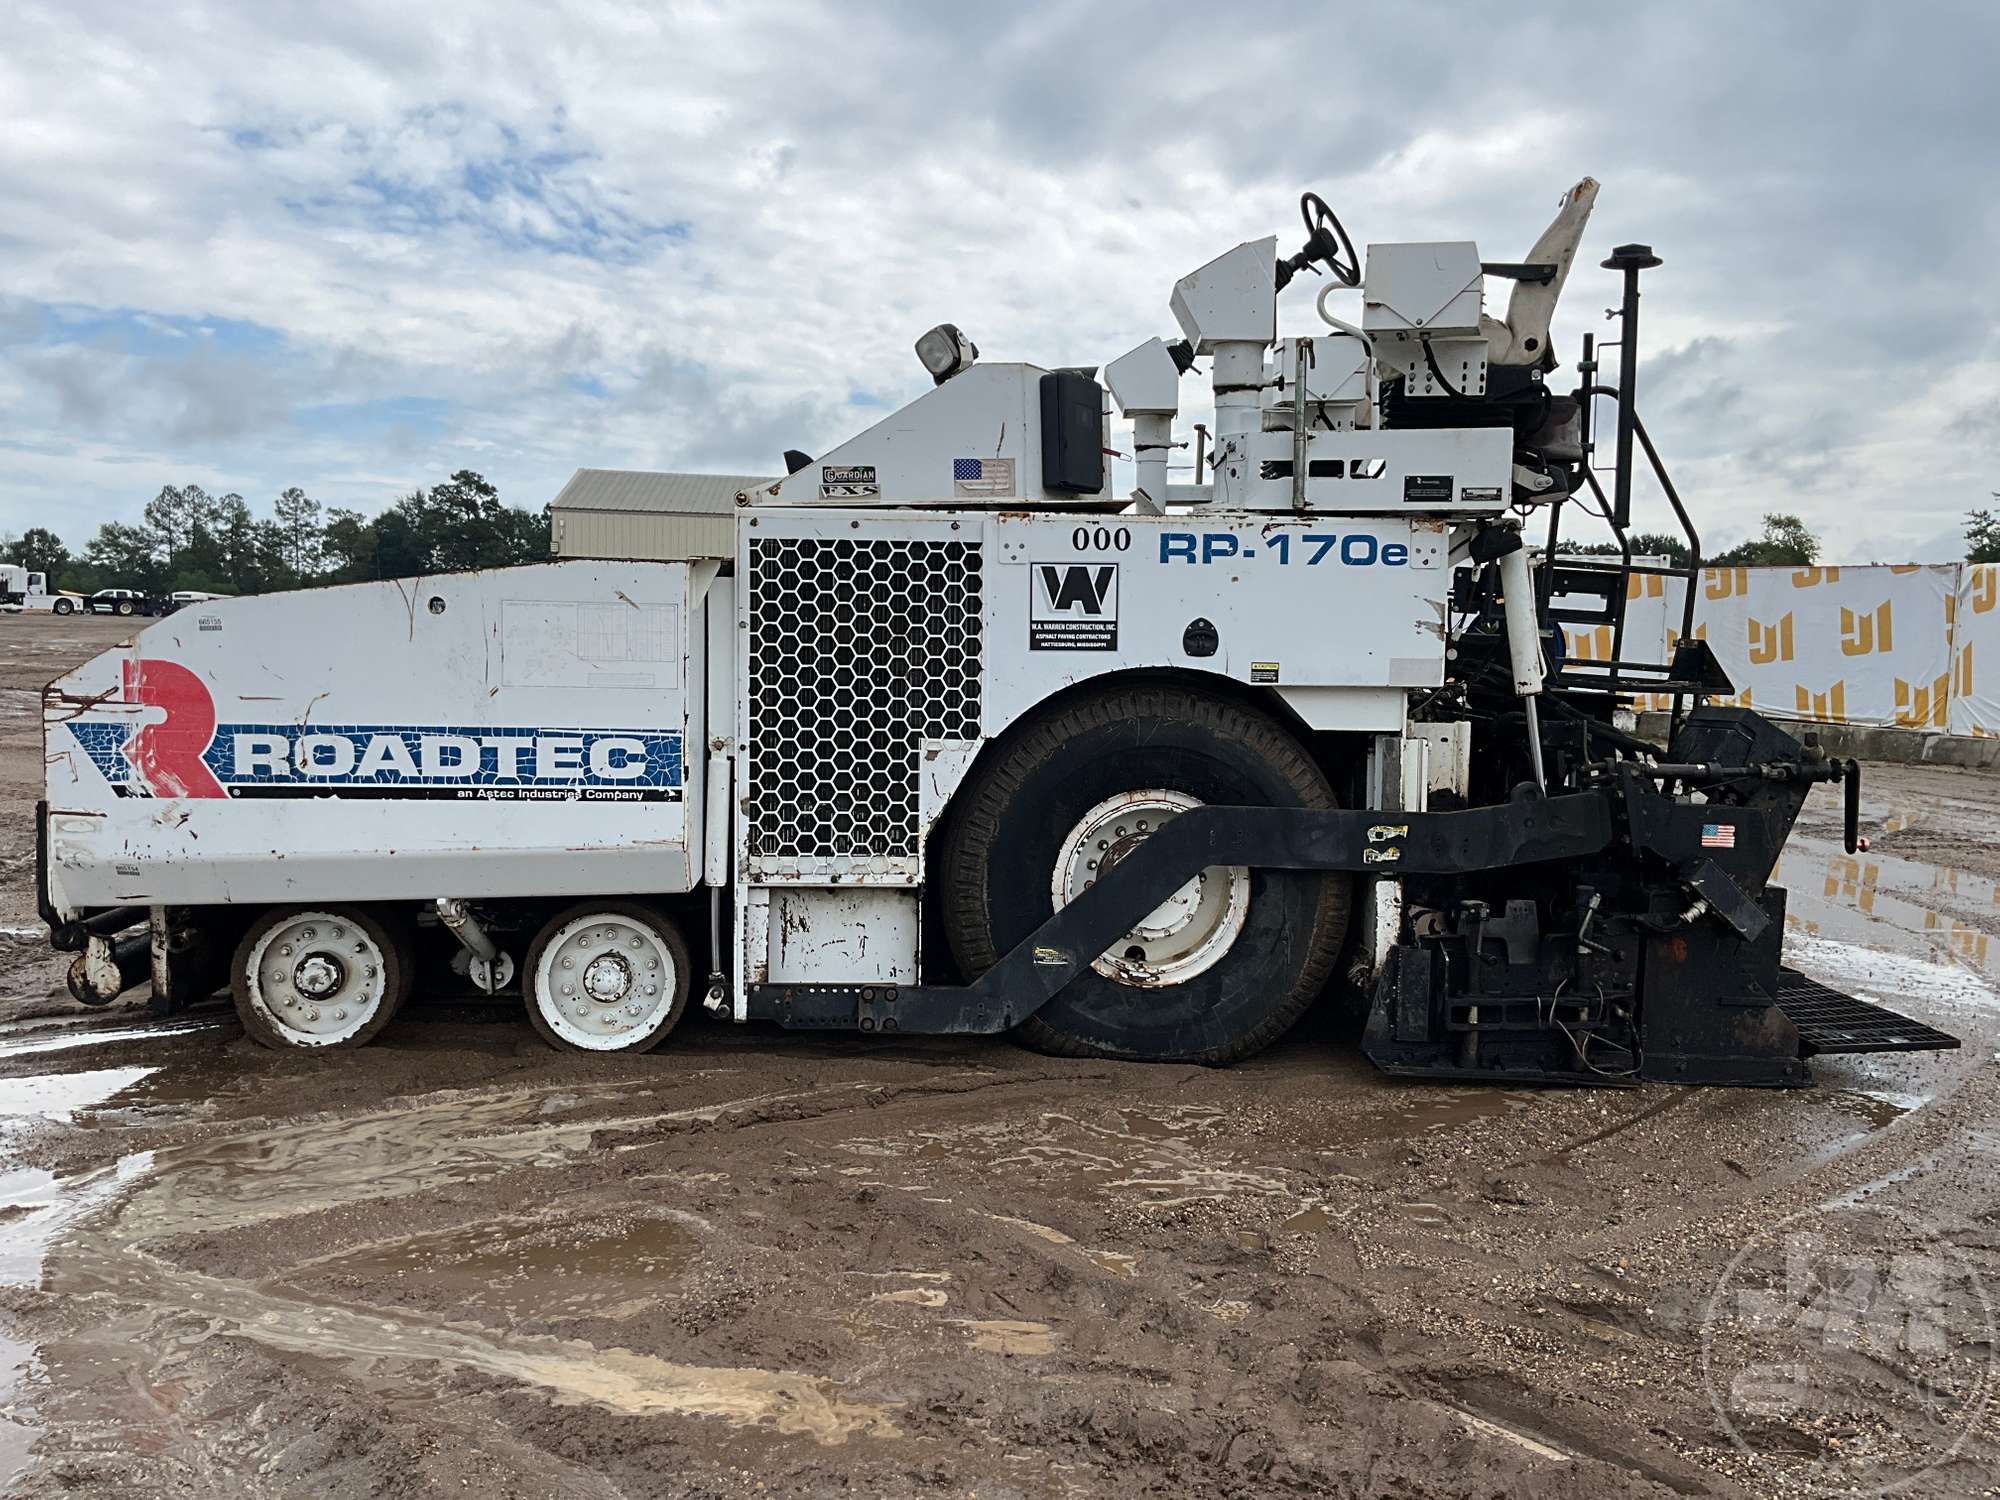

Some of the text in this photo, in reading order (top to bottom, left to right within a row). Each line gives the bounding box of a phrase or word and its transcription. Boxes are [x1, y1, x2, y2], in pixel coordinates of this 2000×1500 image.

[825, 469, 875, 482] GUARDIAN
[1072, 527, 1131, 551] 000
[1160, 532, 1408, 565] RP-170e
[1066, 623, 1105, 631] CONSTRUCTION,
[234, 734, 646, 780] ROADTEC
[457, 789, 644, 801] an Astec Industries Company
